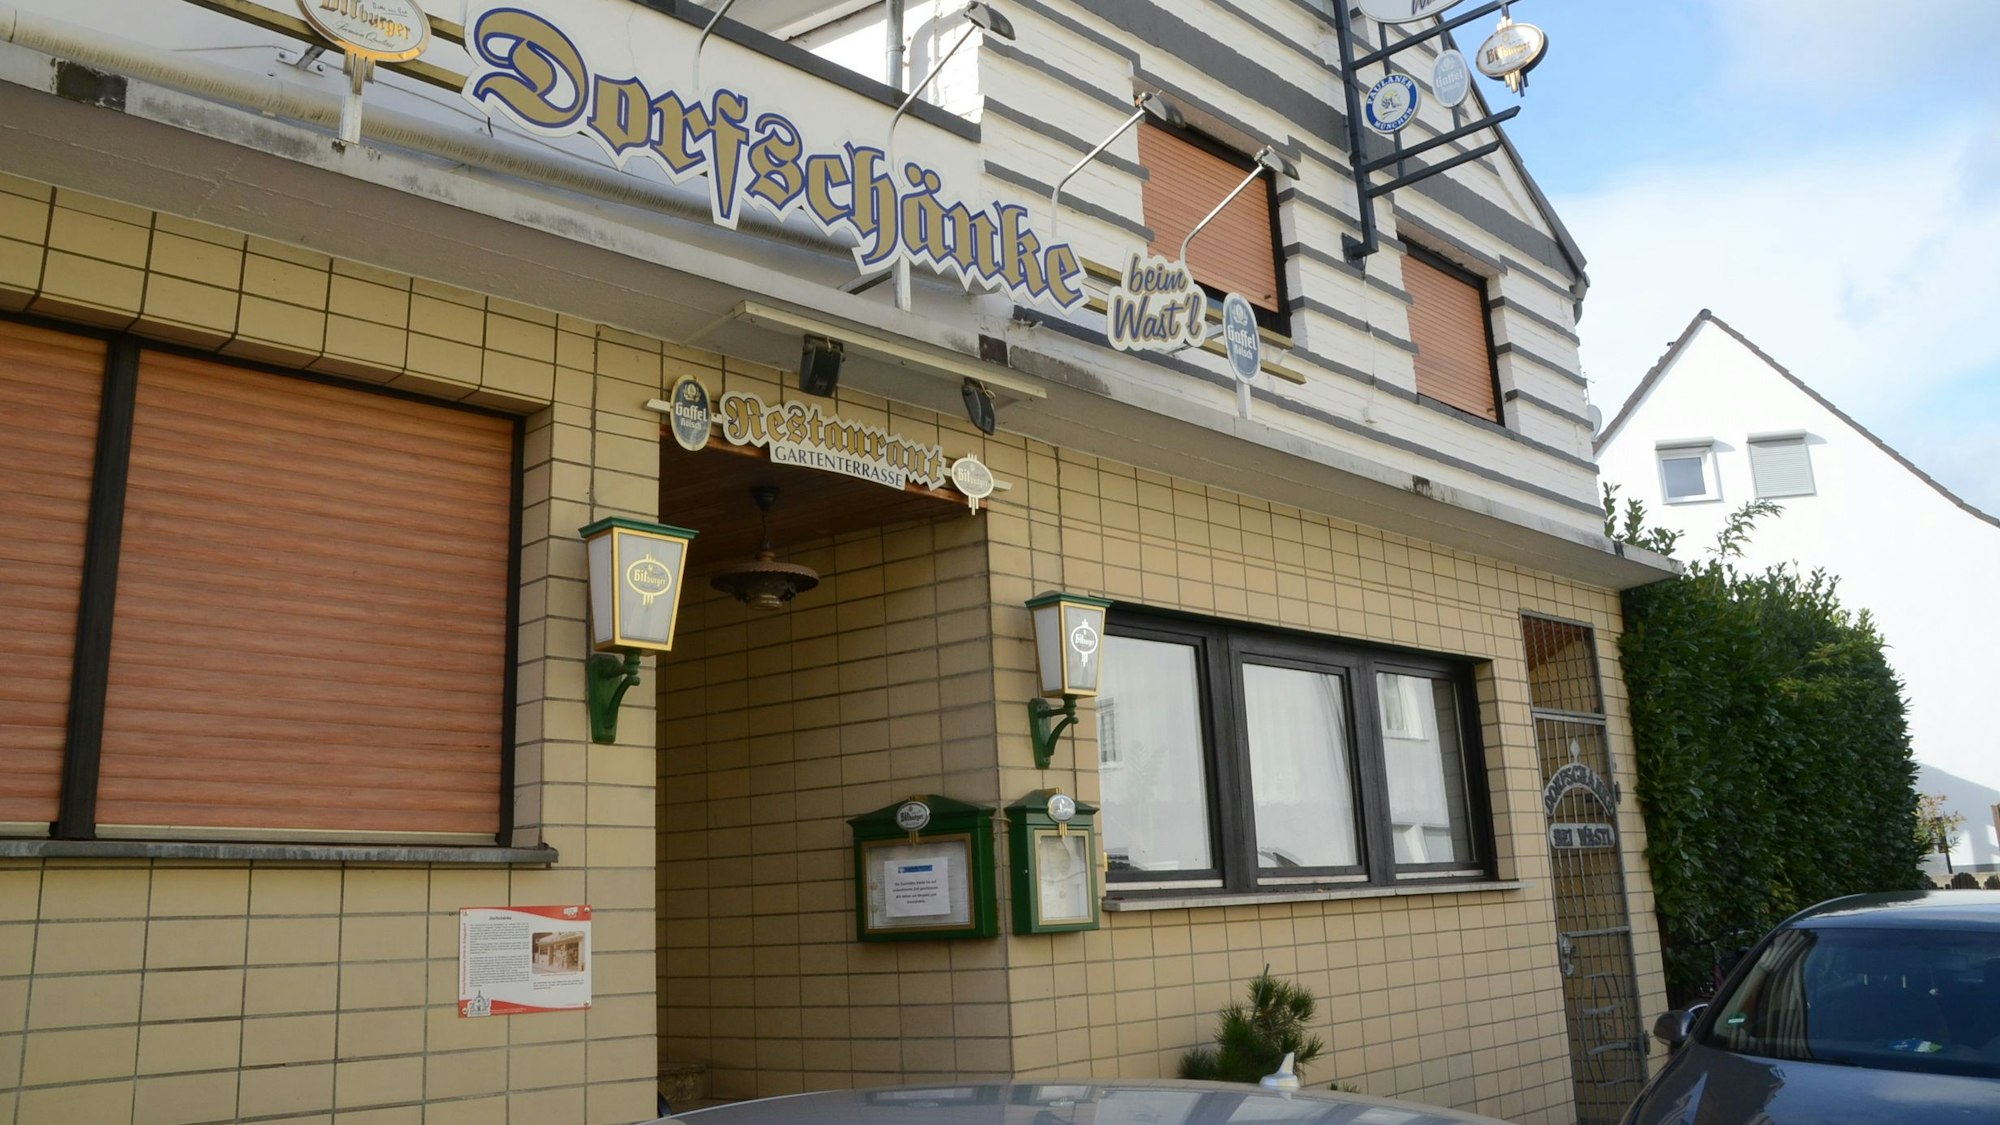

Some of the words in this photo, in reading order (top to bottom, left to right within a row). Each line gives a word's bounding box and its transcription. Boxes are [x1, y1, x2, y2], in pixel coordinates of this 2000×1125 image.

[1367, 75, 1414, 105] PAULANER
[1373, 107, 1414, 130] MÜNCHEN
[473, 7, 1082, 307] Dorfschänke
[1129, 253, 1188, 296] beim
[1113, 292, 1201, 341] Wast'l
[1227, 324, 1257, 351] Gaffel
[675, 402, 708, 422] Gaffel
[725, 395, 942, 483] Restaurant
[774, 446, 903, 488] GARTENTERRASSE
